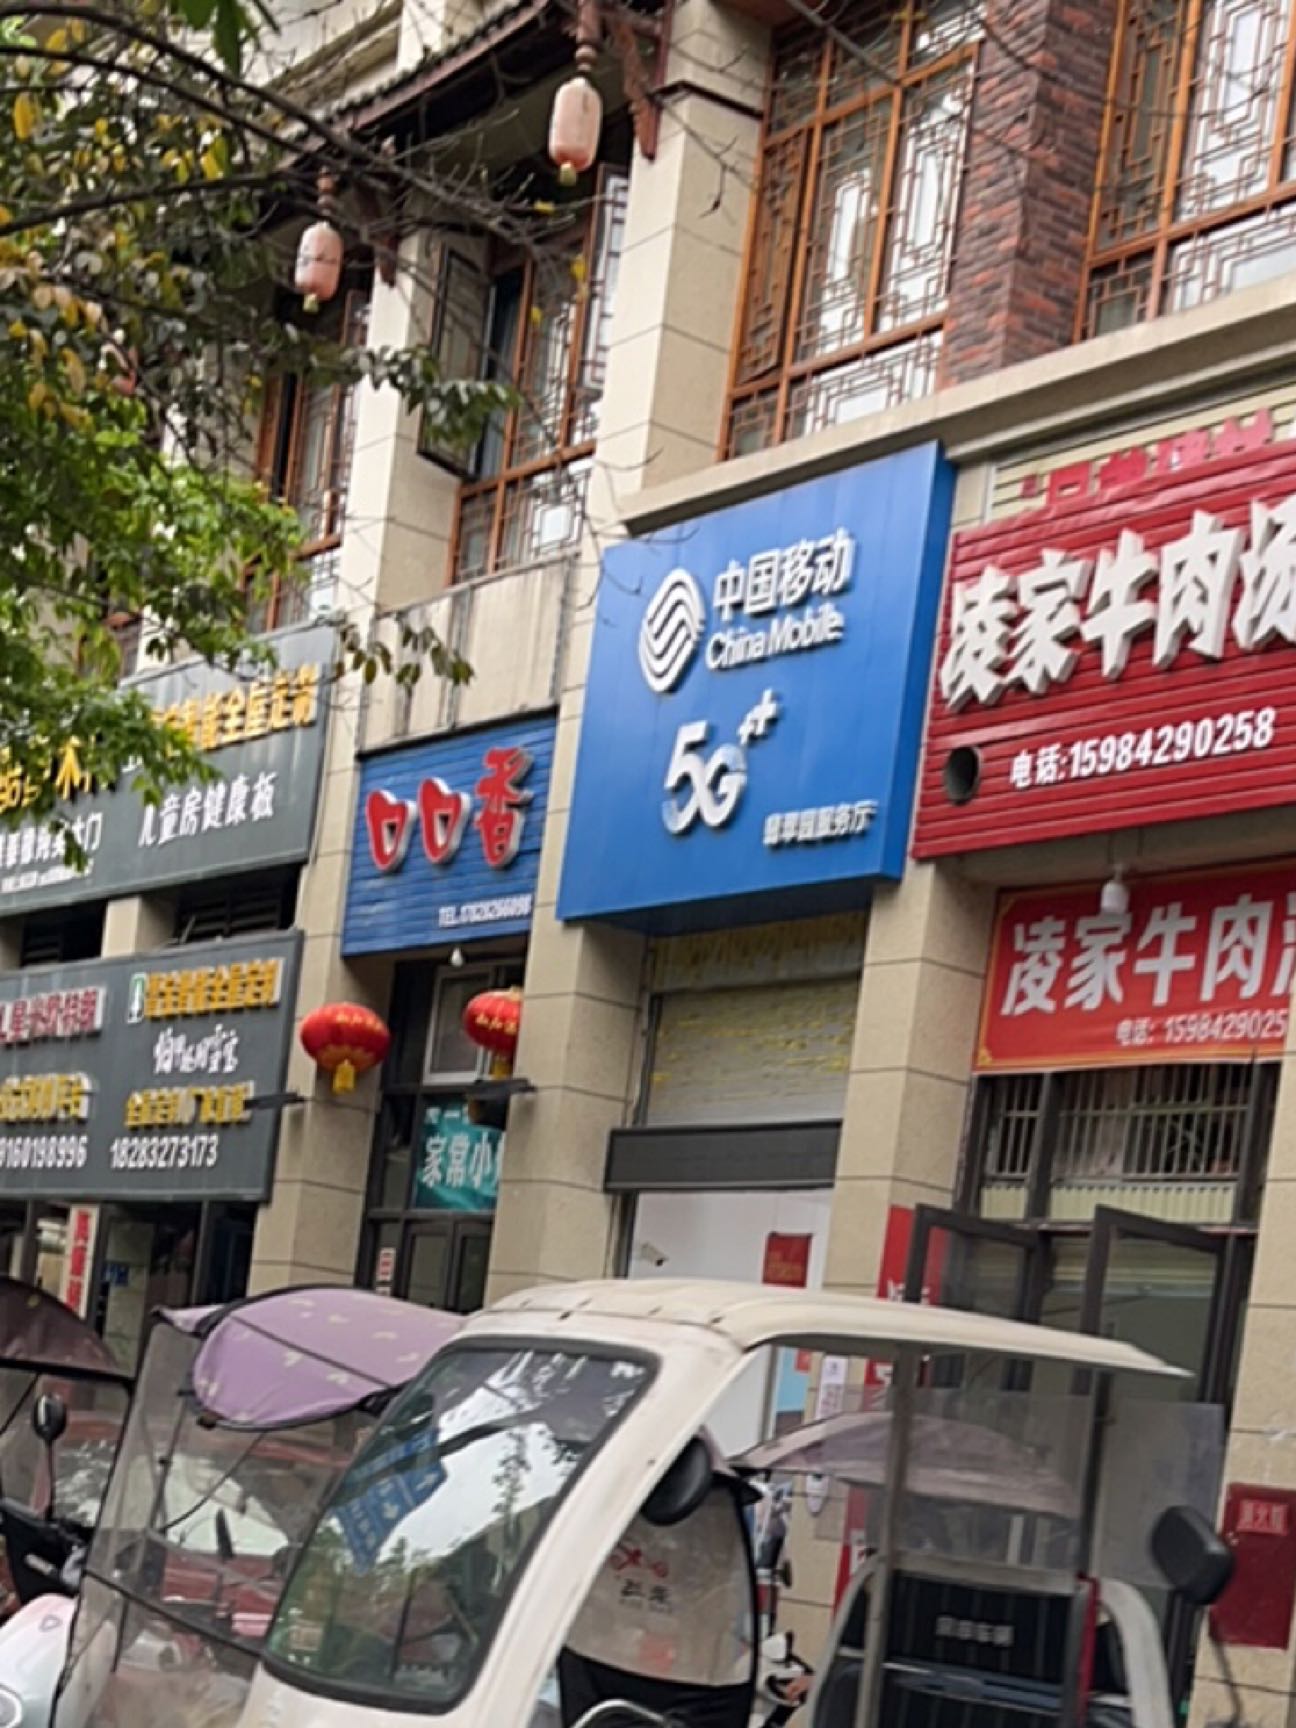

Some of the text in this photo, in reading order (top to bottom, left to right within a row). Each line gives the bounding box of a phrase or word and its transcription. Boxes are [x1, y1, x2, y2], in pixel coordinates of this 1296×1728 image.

[712, 528, 855, 621] 中国移动
[705, 602, 846, 672] China Mobile
[421, 1131, 504, 1190] 家常小
